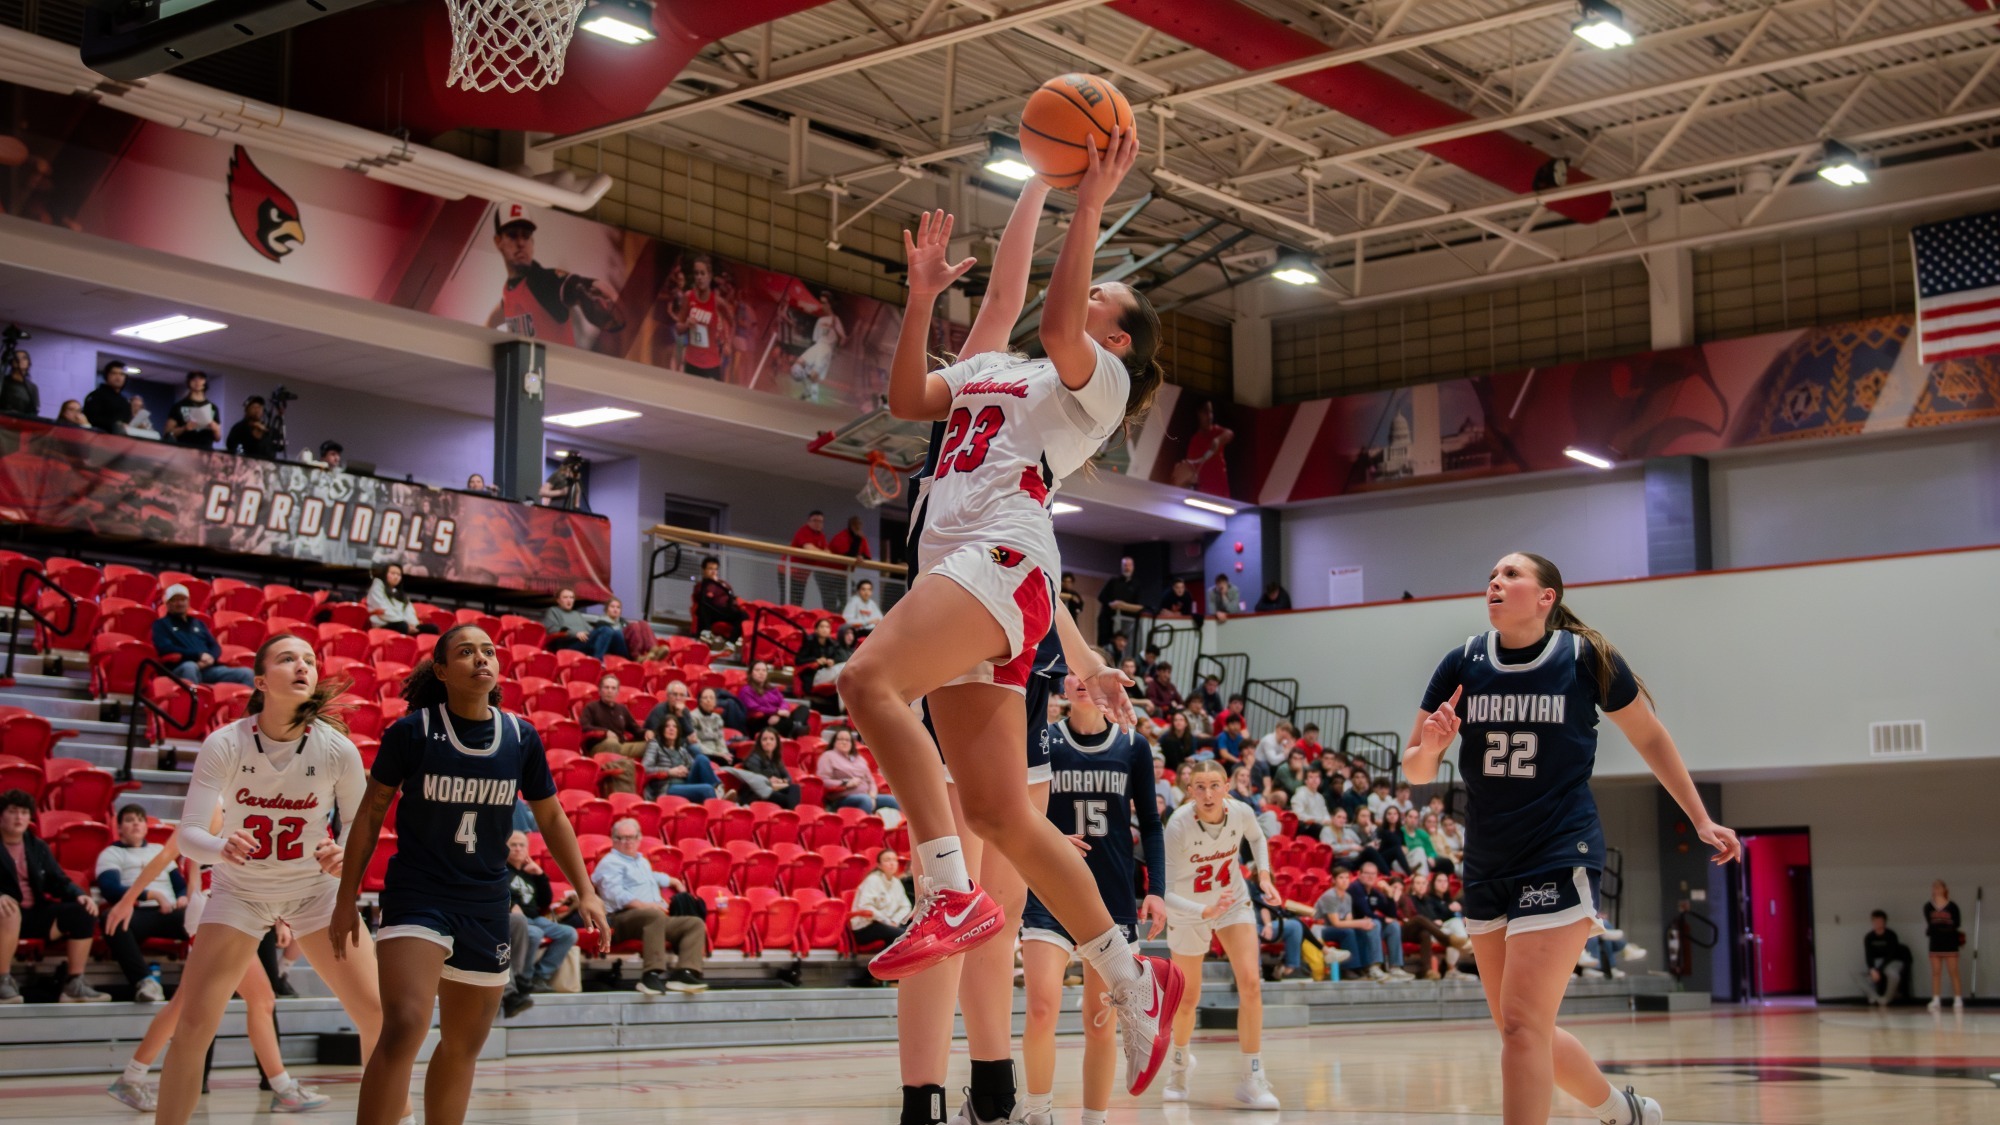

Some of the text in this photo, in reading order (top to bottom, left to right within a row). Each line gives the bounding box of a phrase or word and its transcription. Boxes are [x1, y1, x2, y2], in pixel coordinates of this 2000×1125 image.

[935, 405, 1006, 481] 23
[205, 483, 456, 555] CARDINALS
[1467, 694, 1566, 724] MORAVIAN
[305, 766, 316, 777] JR
[1482, 730, 1539, 779] 22
[235, 787, 319, 811] Cardinals
[423, 774, 518, 807] MORAVIAN
[1051, 769, 1129, 797] MORAVIAN
[455, 811, 478, 854] 4
[1073, 799, 1109, 837] 15
[243, 814, 308, 862] 32
[1193, 859, 1233, 894] 24
